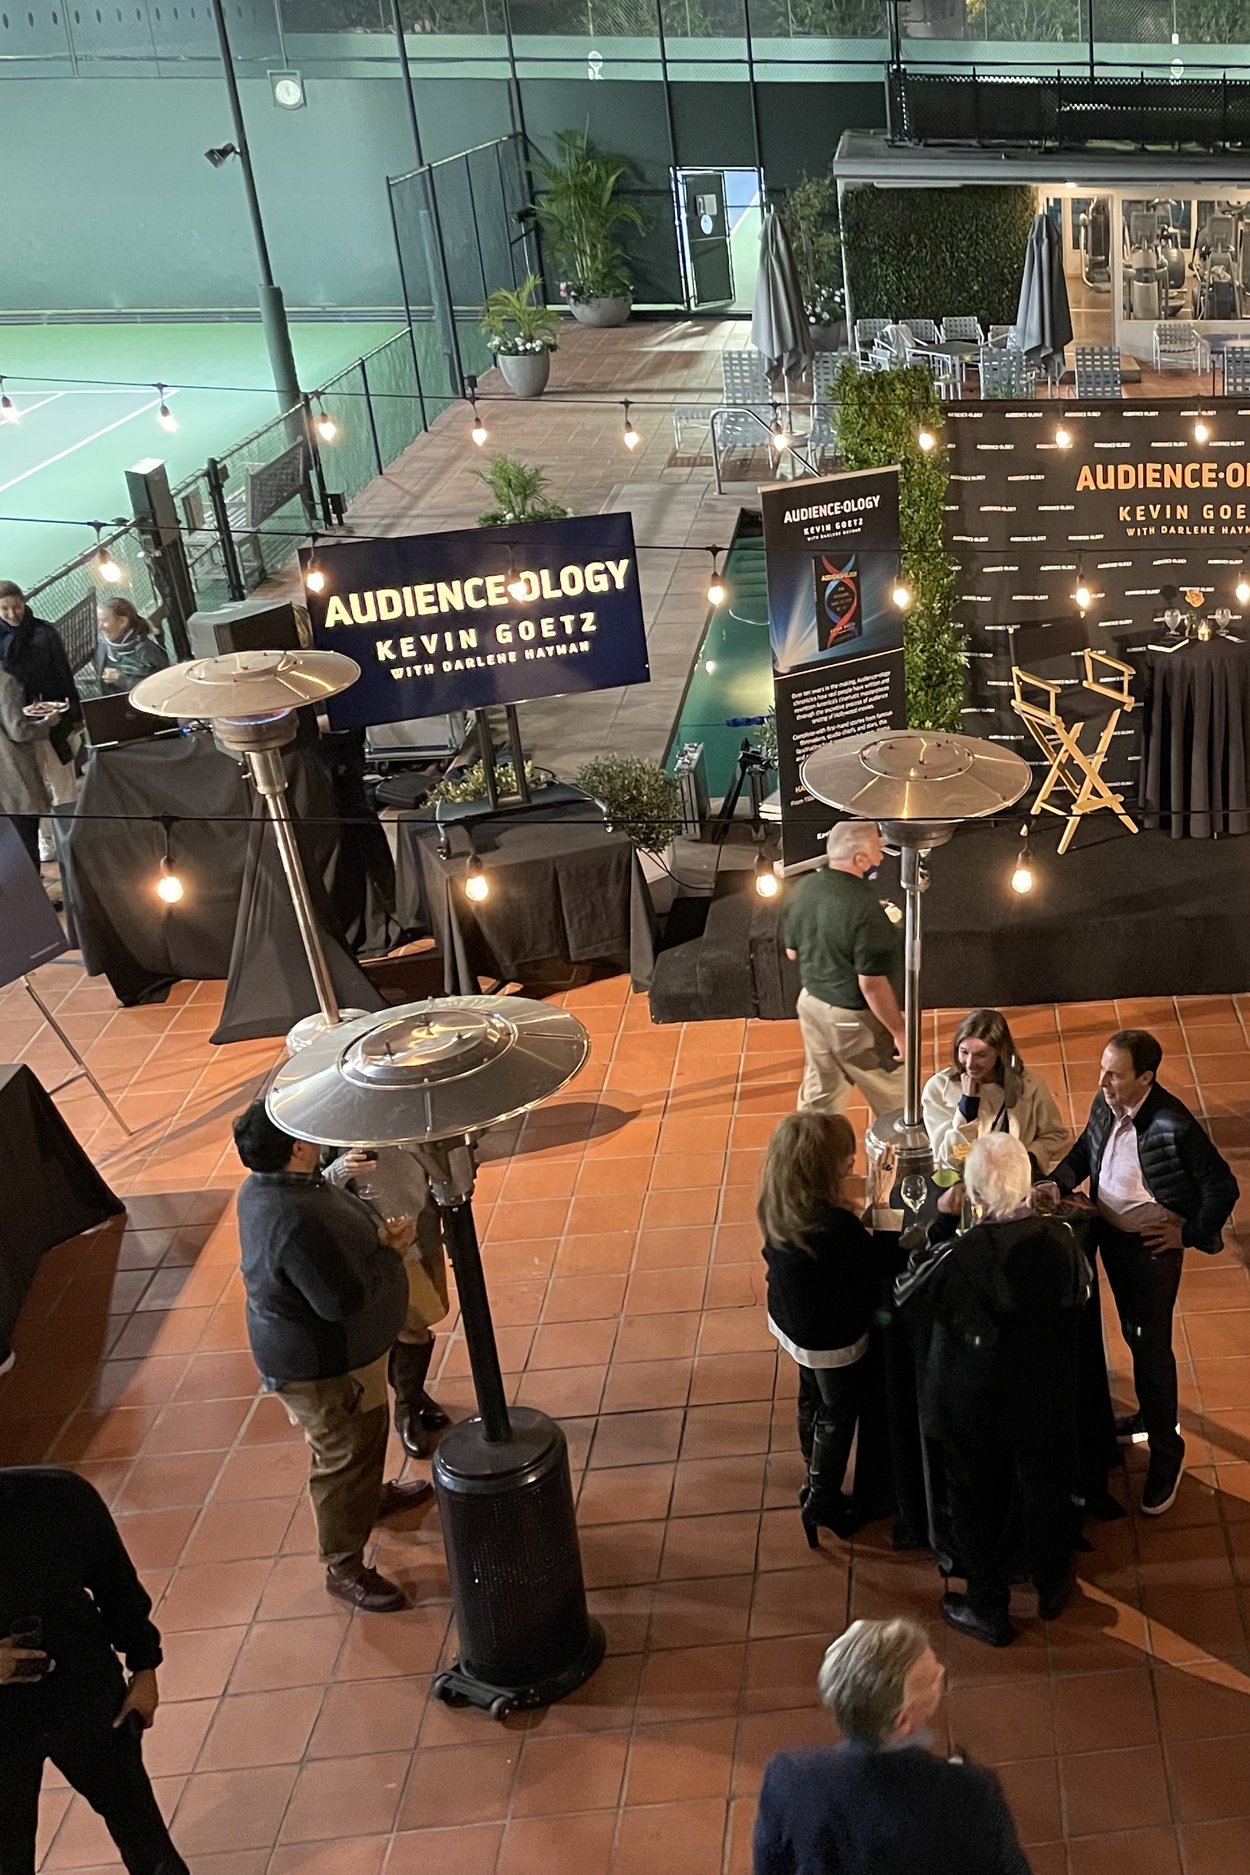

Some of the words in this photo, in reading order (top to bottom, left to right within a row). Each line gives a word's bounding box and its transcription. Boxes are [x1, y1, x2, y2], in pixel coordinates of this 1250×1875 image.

[1119, 504, 1189, 522] KEVIN
[803, 524, 831, 536] KEVIN
[835, 518, 863, 529] GOETZ
[1126, 526, 1155, 536] WITH
[1161, 525, 1215, 535] DARLENE
[376, 629, 478, 661] KEVIN
[495, 611, 597, 644] GOETZ
[390, 665, 434, 680] WITH
[442, 652, 517, 672] DARLENE
[525, 640, 589, 660] HAYMAN
